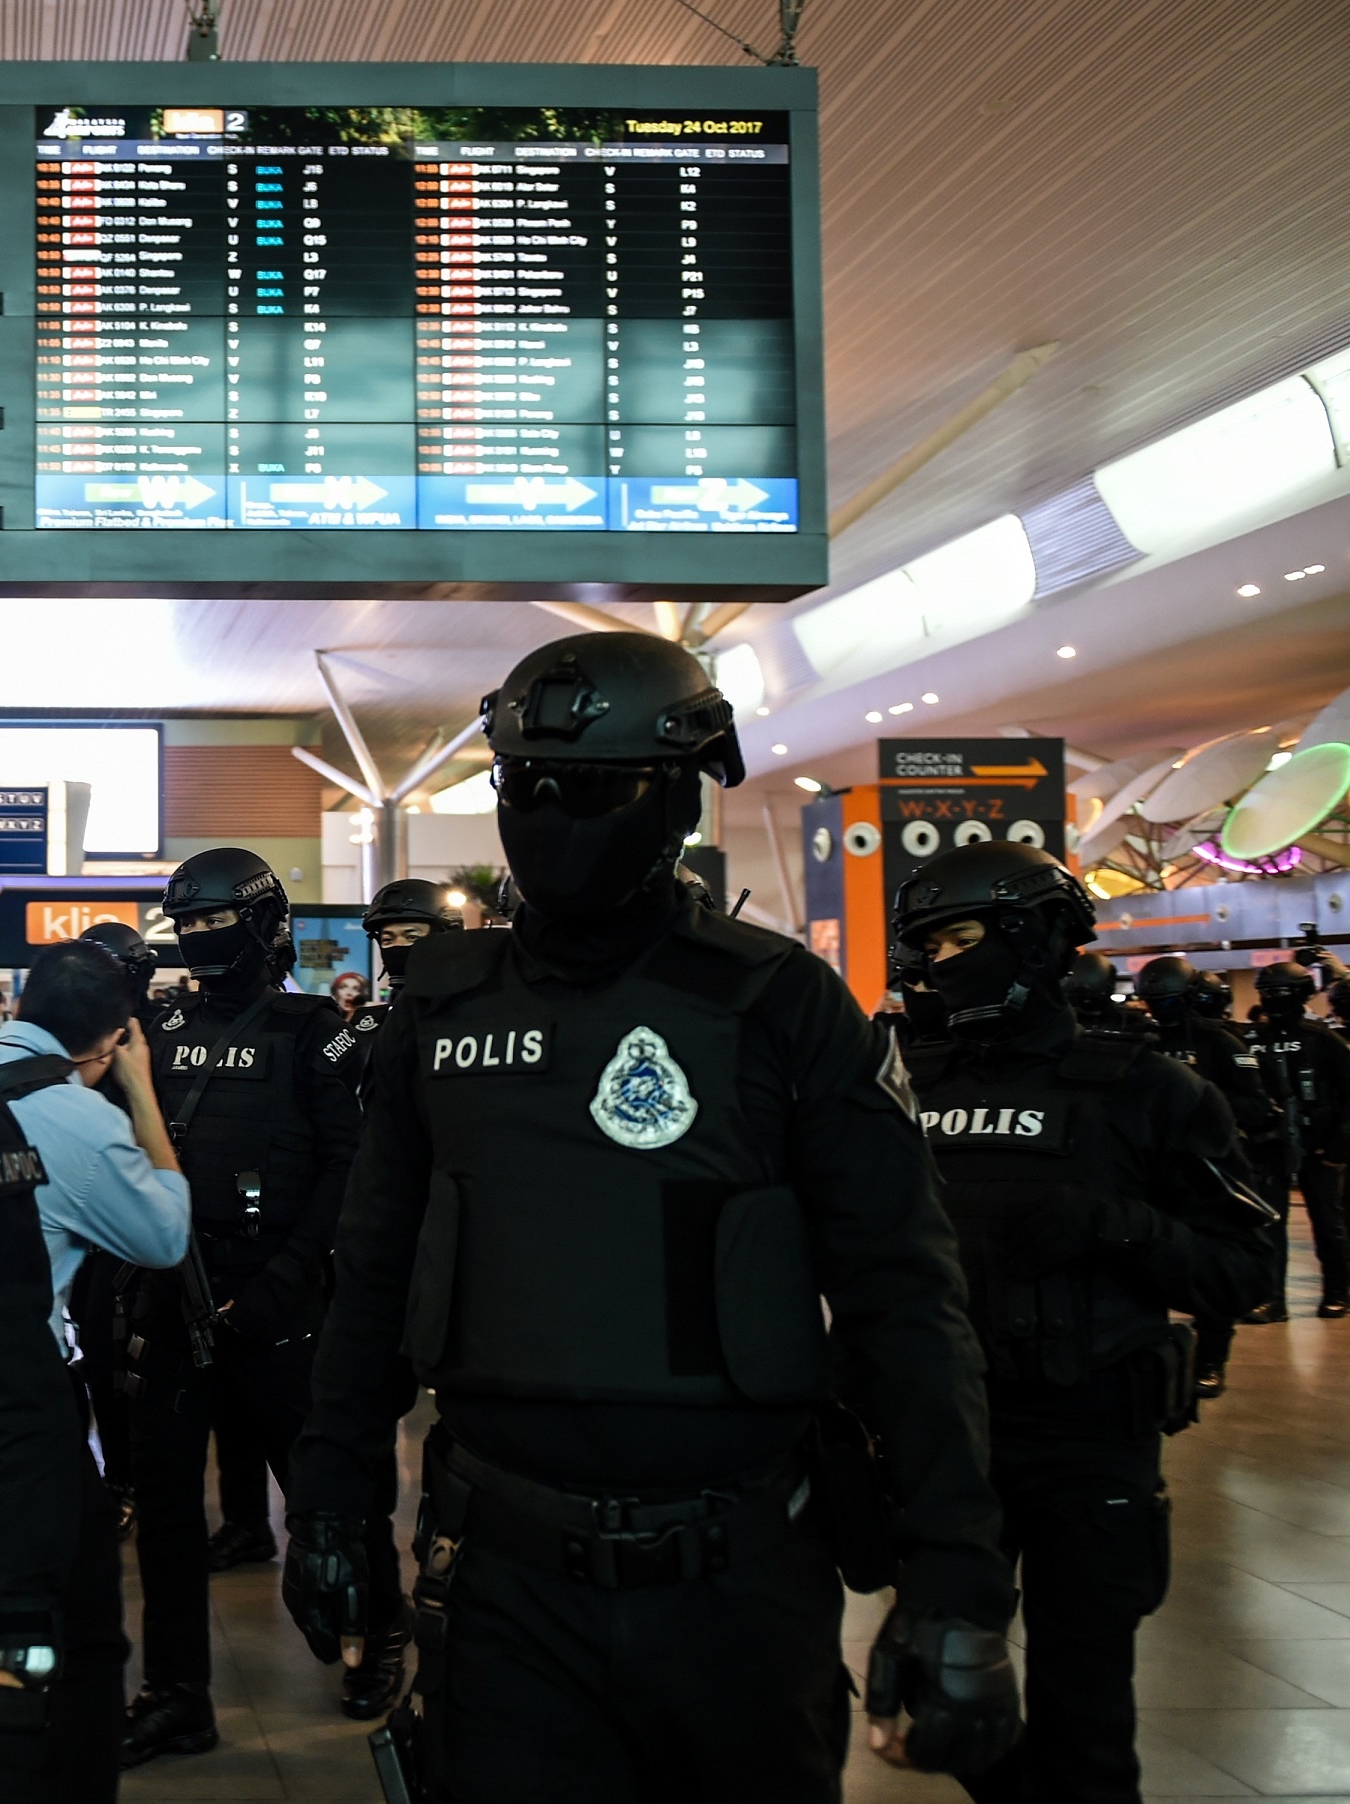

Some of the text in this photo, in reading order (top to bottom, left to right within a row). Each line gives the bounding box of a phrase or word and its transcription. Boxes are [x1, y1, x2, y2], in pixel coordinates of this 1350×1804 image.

[227, 113, 245, 131] 2
[626, 120, 762, 135] Tuesday 24 Oct 2017
[37, 146, 61, 155] TIME
[82, 146, 117, 155] FLIGHT
[137, 146, 199, 155] DESTINATION
[257, 146, 297, 155] REMARK
[298, 146, 323, 155] GATE
[328, 146, 349, 155] ETD
[351, 146, 389, 155] STATUS
[415, 148, 439, 157] TIME
[460, 148, 495, 157] FLIGHT
[515, 148, 577, 157] DESTINATION
[633, 148, 673, 157] REMARK
[674, 148, 700, 157] GATE
[705, 148, 726, 157] ETD
[728, 148, 765, 157] STATUS
[256, 166, 283, 174] BUKA
[680, 167, 701, 177] L12
[256, 201, 283, 209] BUKA
[257, 237, 284, 246] BUKA
[303, 252, 319, 262] L3
[607, 253, 616, 264] S
[304, 269, 327, 280] Q17
[607, 271, 703, 281] U P21
[257, 286, 320, 297] BUKA P7
[607, 288, 618, 298] V
[257, 306, 284, 314] BUKA
[607, 305, 617, 315] S
[258, 464, 285, 472] BUKA
[138, 475, 180, 509] W
[323, 475, 353, 510] X
[514, 476, 545, 511] Y
[696, 478, 729, 511] Z
[896, 752, 963, 764] CHECK-IN
[896, 765, 964, 776] COUNTER
[144, 907, 176, 941] 2
[323, 1028, 356, 1062] STAFOC
[434, 1030, 543, 1071] POLIS
[919, 1108, 1045, 1137] POLIS
